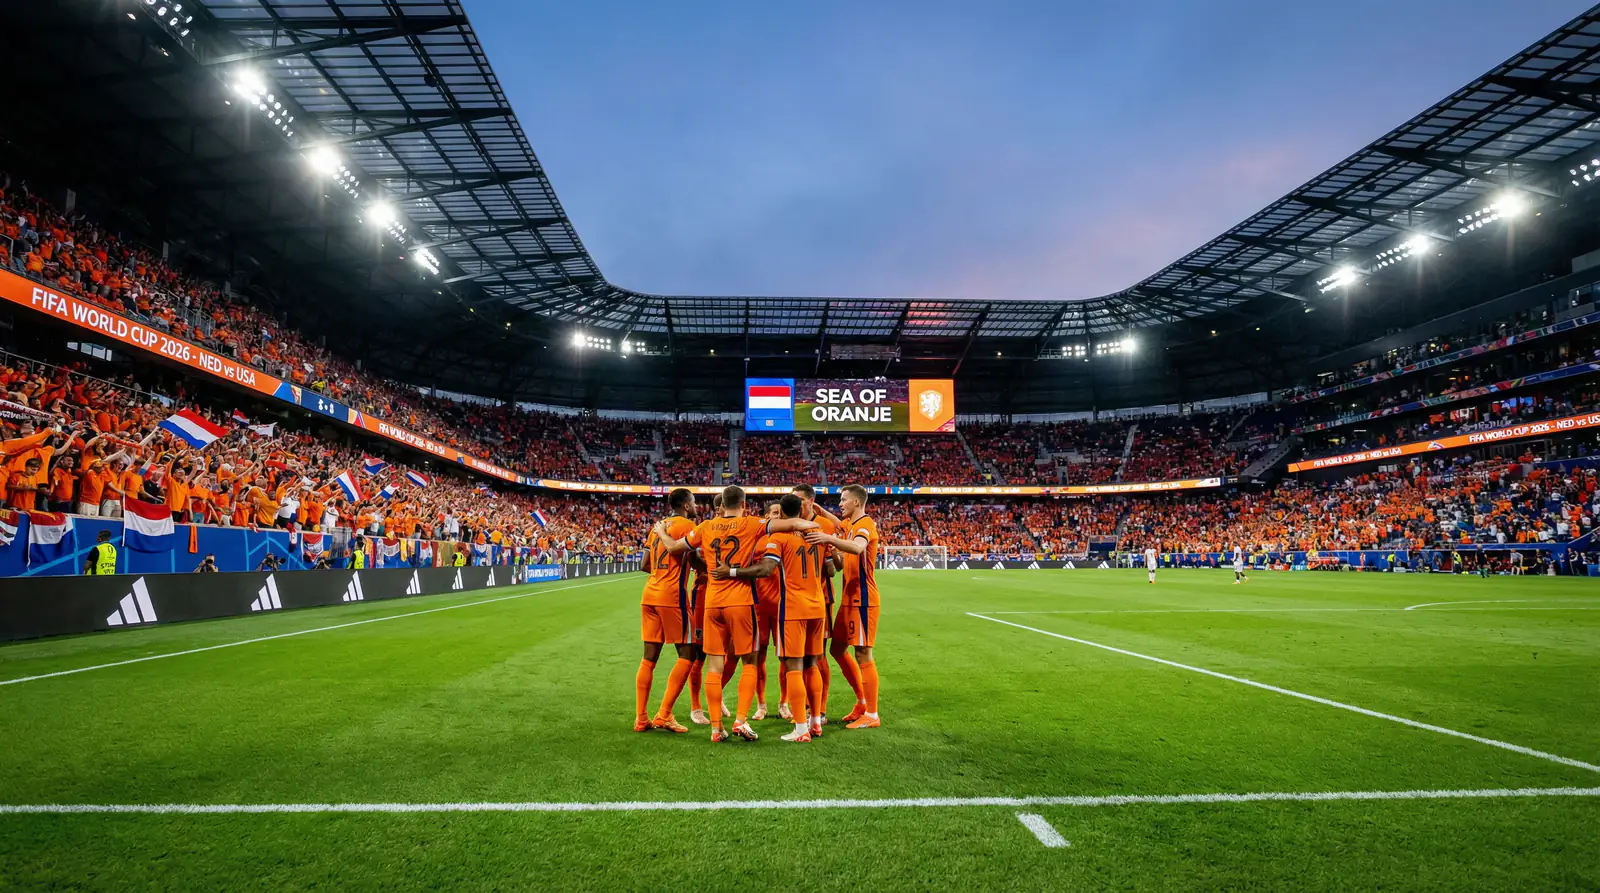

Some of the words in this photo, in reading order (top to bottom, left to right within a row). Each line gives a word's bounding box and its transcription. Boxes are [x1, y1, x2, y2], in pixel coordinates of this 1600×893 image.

[32, 287, 68, 316] FIFA
[72, 302, 128, 338] WORLD
[130, 326, 158, 348] CUP
[160, 337, 190, 361] 2026
[199, 352, 222, 373] NED
[224, 364, 235, 378] vs
[236, 366, 256, 386] USA
[816, 388, 855, 404] SEA
[859, 388, 886, 404] OF
[811, 406, 891, 422] ORANJE
[1469, 434, 1485, 443] FIFA
[1485, 429, 1513, 440] WORLD
[1514, 426, 1529, 436] CUP
[1556, 419, 1574, 429] NED
[709, 535, 741, 568] 12
[796, 544, 820, 579] 11
[849, 620, 855, 635] 9
